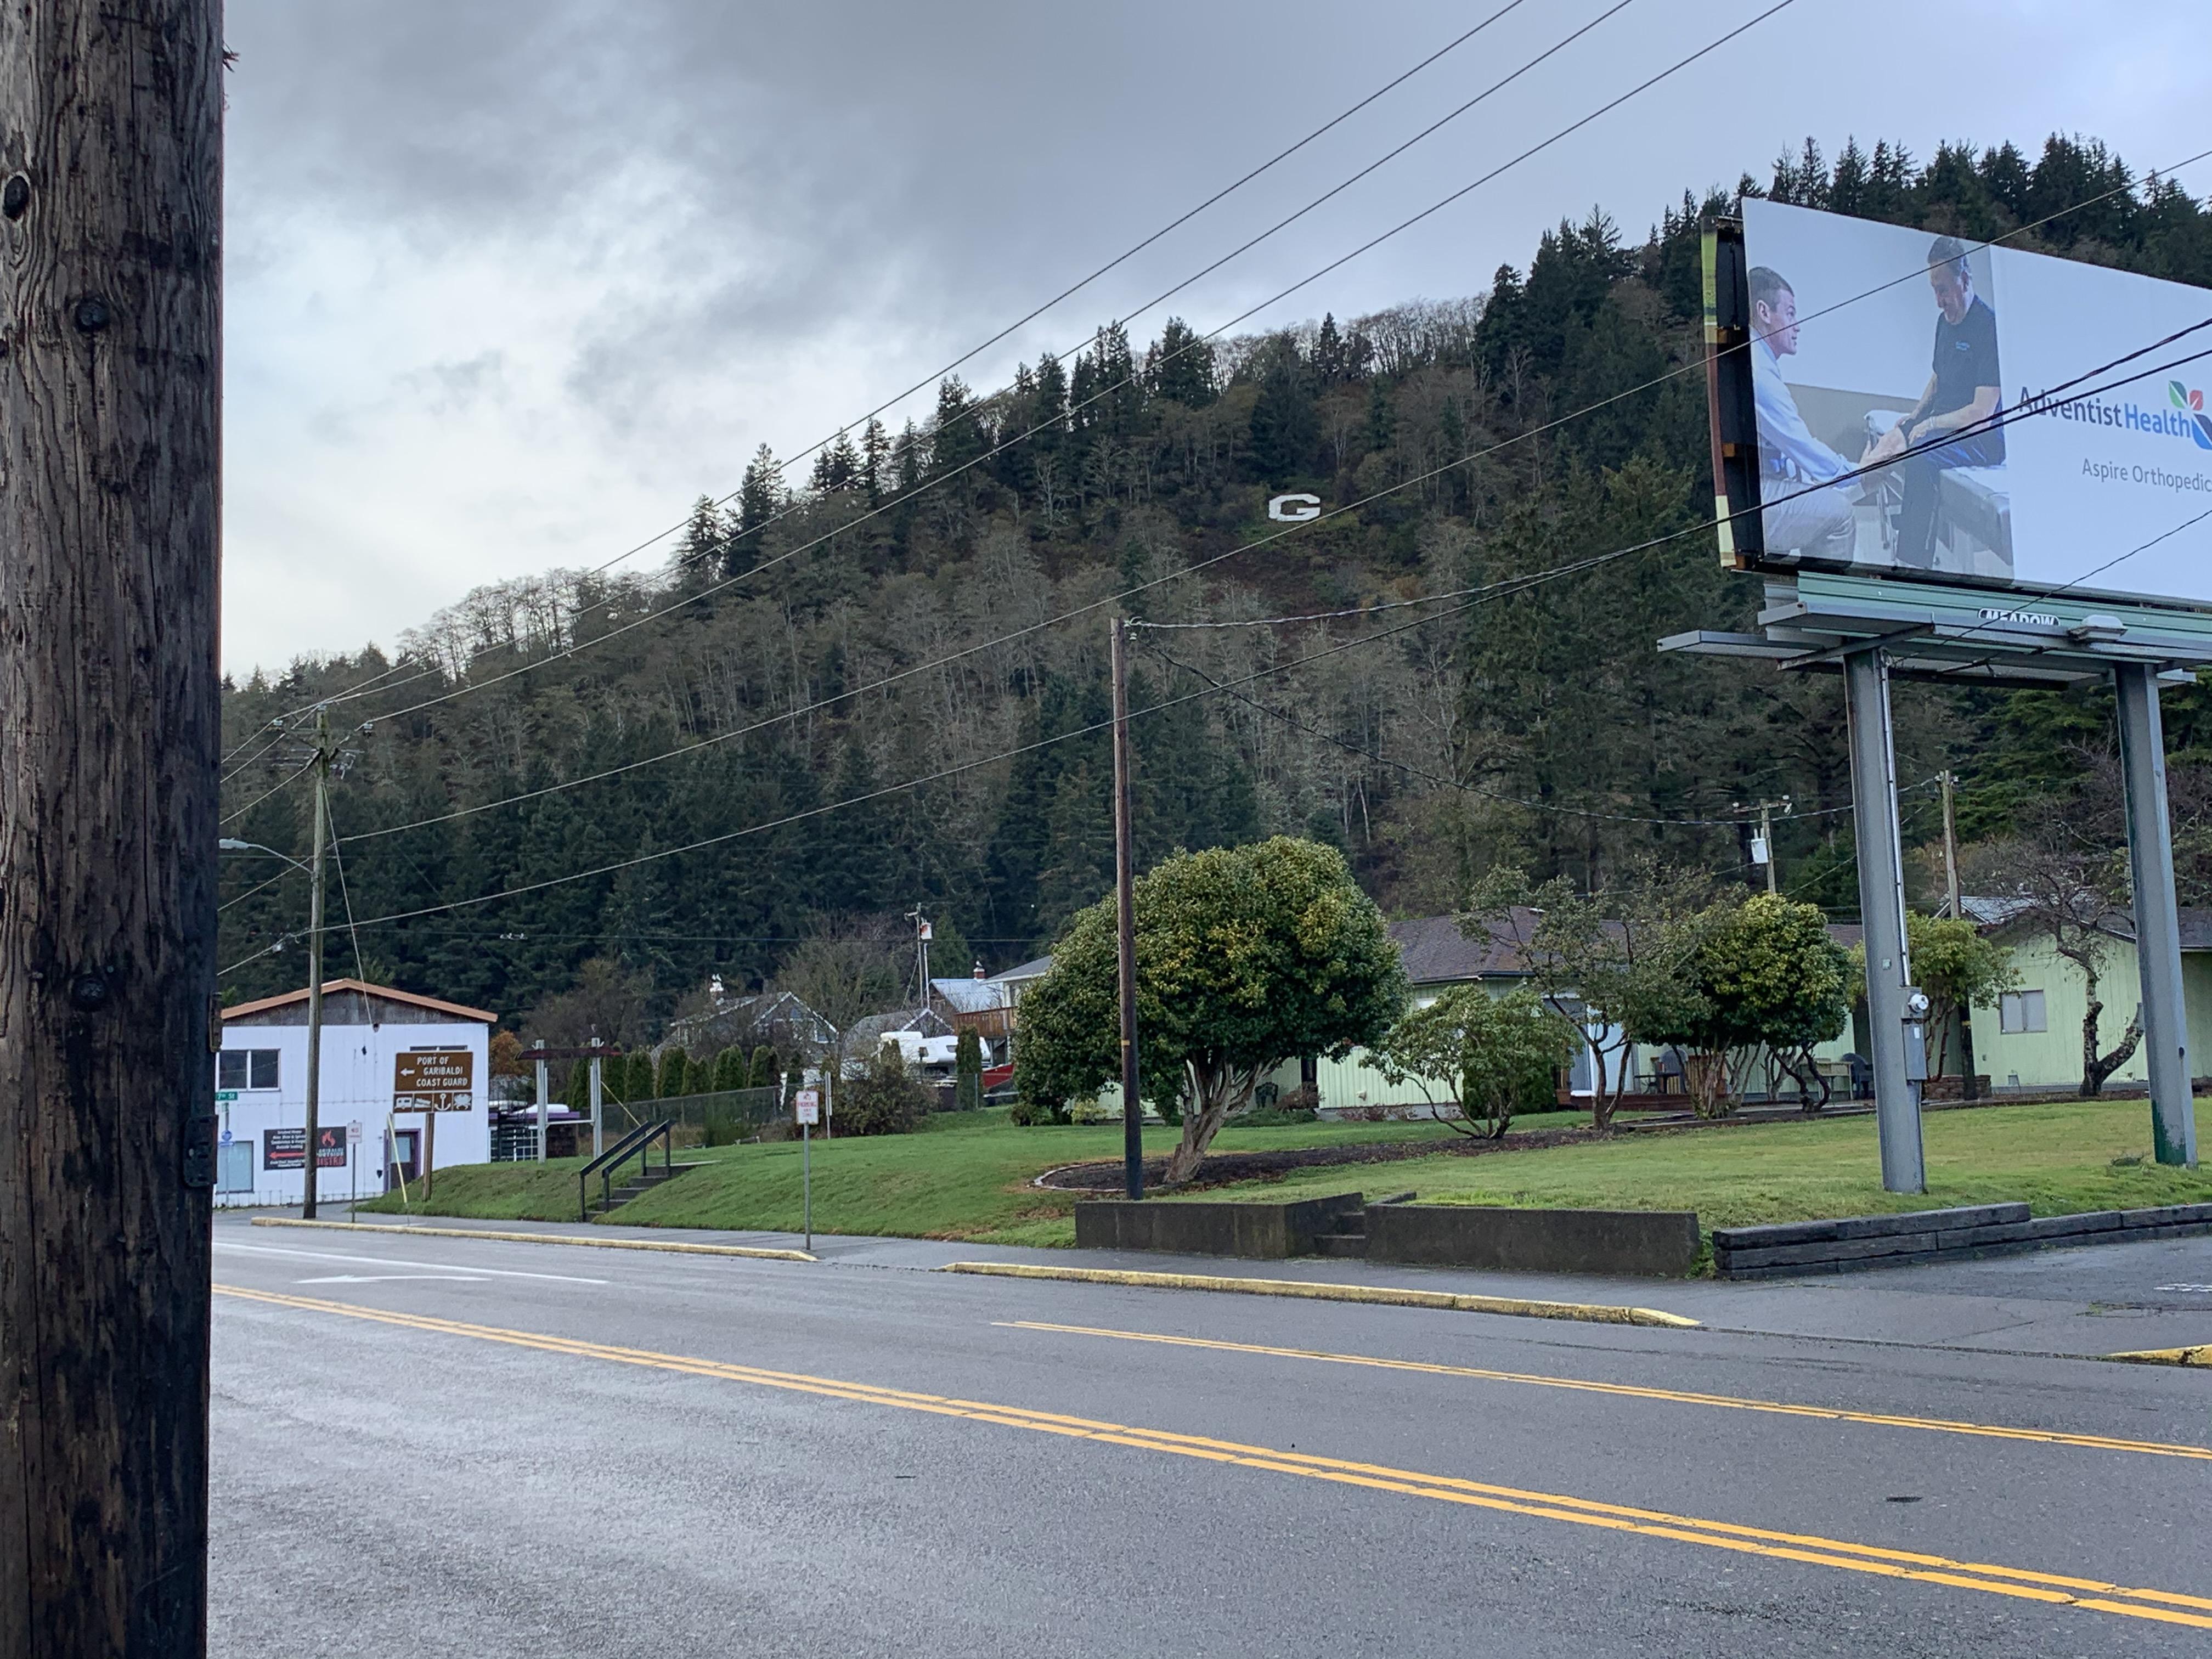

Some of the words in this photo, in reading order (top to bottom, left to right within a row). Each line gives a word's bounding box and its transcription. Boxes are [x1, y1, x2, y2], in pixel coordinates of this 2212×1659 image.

[2082, 458, 2129, 482] Aspire
[2132, 465, 2212, 493] Orthopedic
[1268, 493, 1321, 522] G
[417, 1056, 437, 1065] PORT
[439, 1056, 449, 1064] OF
[423, 1066, 464, 1075] GARIBALDI
[416, 1078, 441, 1087] COAST
[442, 1077, 468, 1086] GUARD
